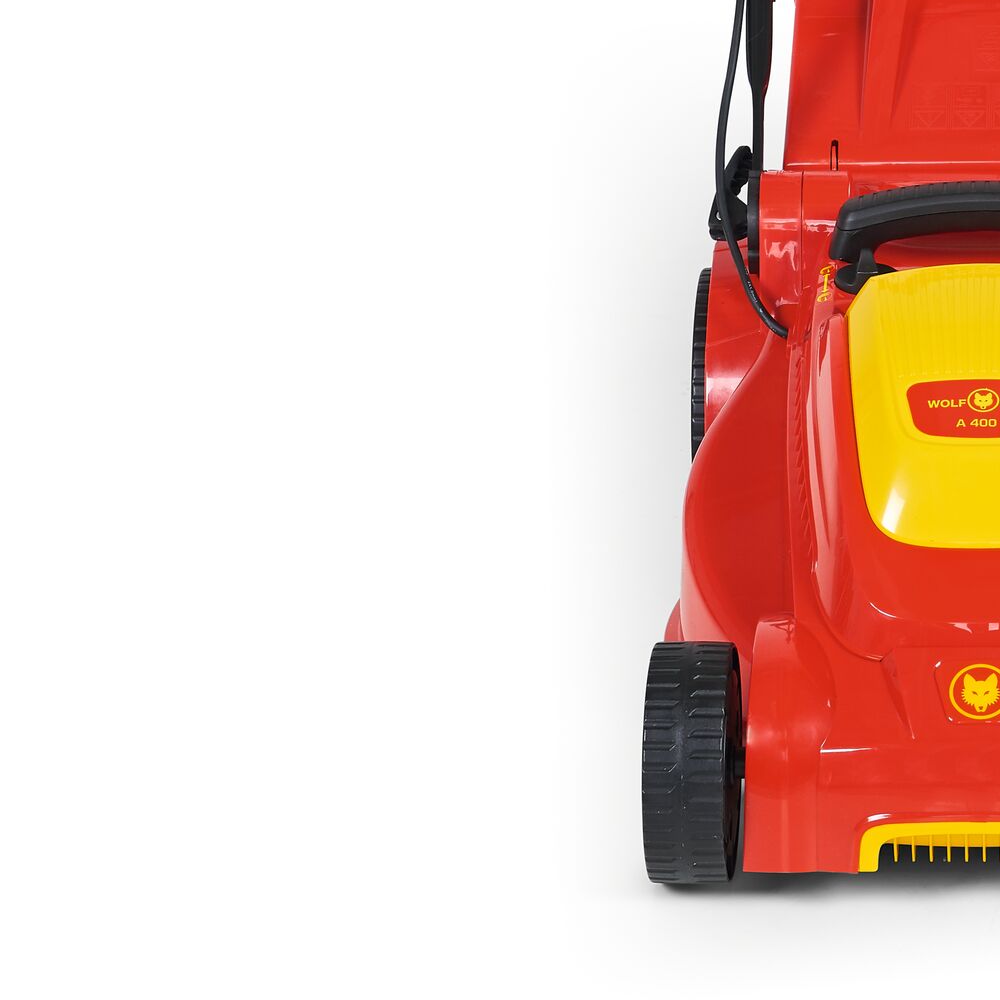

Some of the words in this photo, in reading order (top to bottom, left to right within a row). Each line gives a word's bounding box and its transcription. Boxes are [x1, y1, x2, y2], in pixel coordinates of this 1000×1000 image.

[927, 399, 966, 408] WOLF
[956, 418, 966, 427] A
[969, 418, 997, 427] 400
